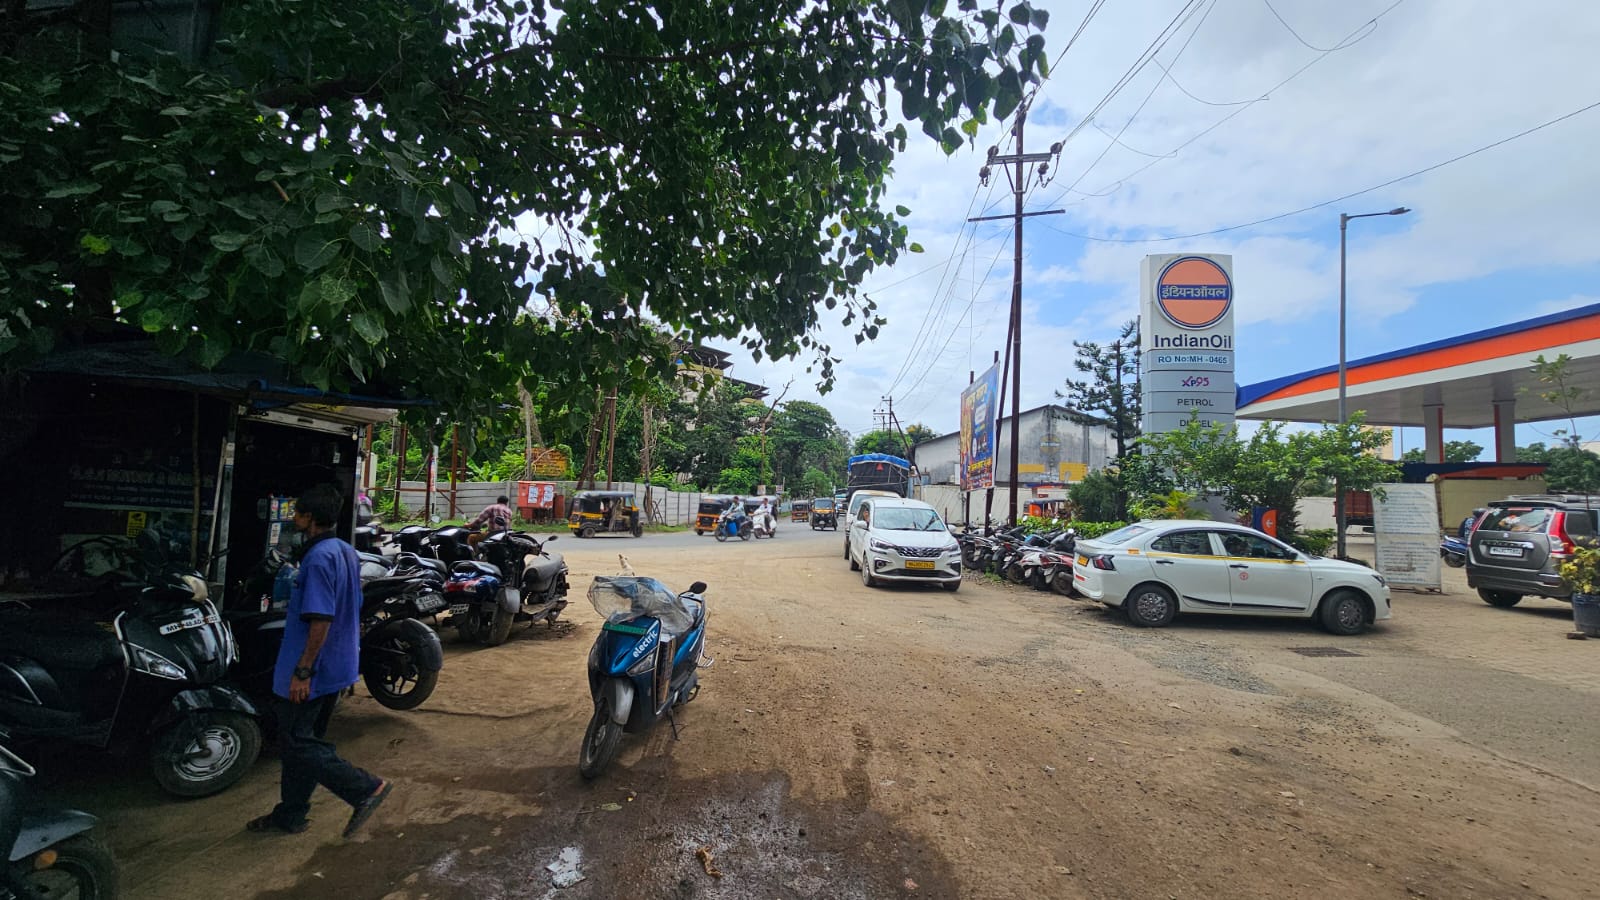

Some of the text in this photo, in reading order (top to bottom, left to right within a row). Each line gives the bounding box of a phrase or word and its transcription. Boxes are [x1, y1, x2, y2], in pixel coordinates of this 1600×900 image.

[1162, 286, 1226, 299] इंडियनऑयल
[1154, 334, 1231, 349] IndianOil
[1177, 398, 1214, 407] PETROL
[1180, 419, 1212, 427] DIEL
[632, 630, 658, 658] electric
